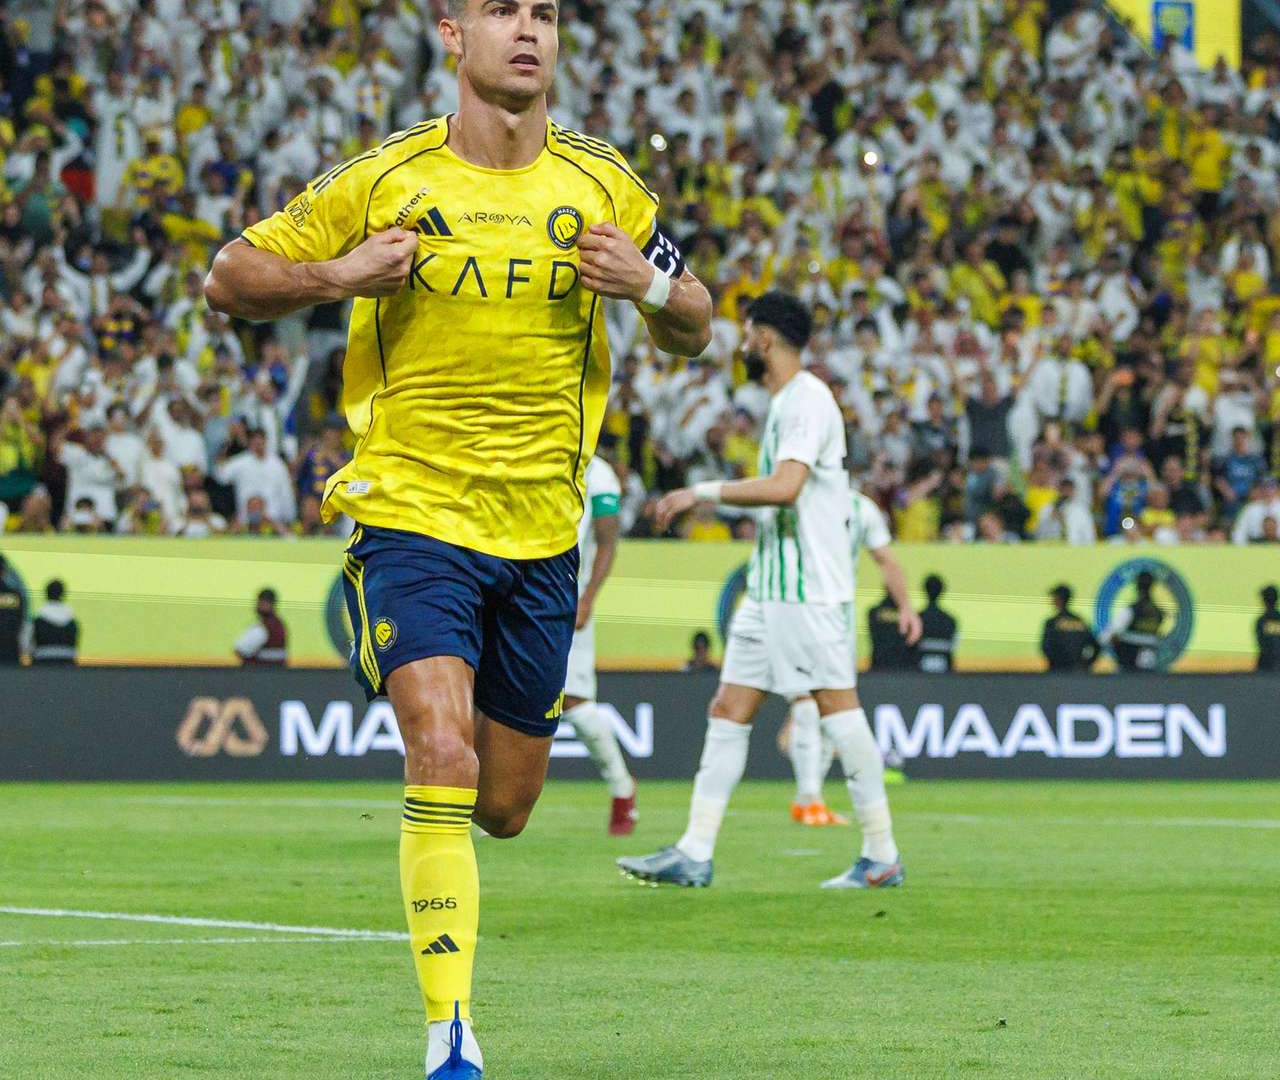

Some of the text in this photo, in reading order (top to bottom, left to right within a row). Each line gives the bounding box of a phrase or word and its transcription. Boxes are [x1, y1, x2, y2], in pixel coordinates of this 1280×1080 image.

[457, 211, 533, 227] AROYA
[408, 251, 579, 300] KAFD
[872, 703, 1228, 758] MAADEN
[411, 897, 457, 913] 1955
